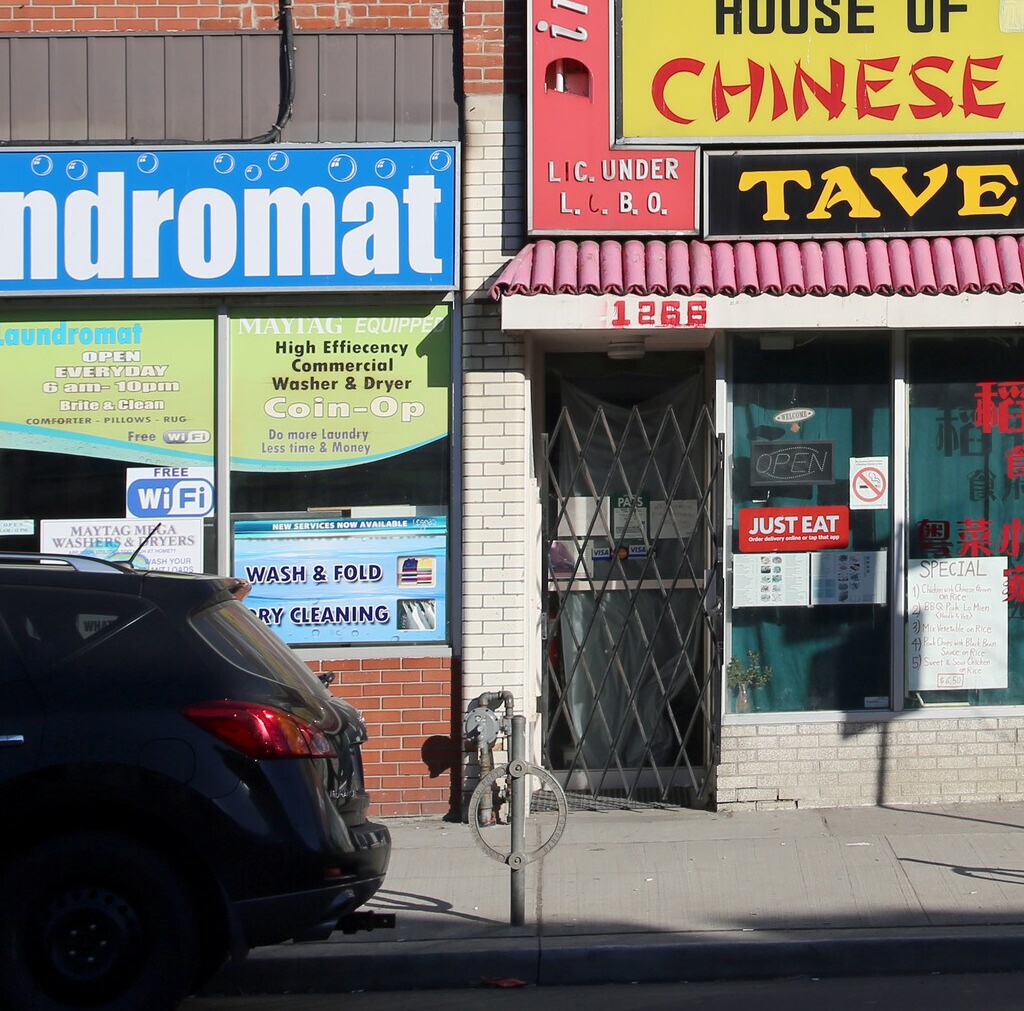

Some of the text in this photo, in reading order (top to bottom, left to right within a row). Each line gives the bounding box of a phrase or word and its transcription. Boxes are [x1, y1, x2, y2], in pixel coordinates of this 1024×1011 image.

[652, 54, 1006, 123] CHINESE
[601, 157, 679, 181] UNDER
[0, 172, 443, 280] ndromat
[612, 300, 706, 327] 1266
[238, 317, 446, 335] MAYTAG EQUIPPED
[0, 321, 142, 346] aundromat
[276, 340, 408, 357] High Effiecency
[82, 351, 141, 363] OPEN
[55, 365, 169, 378] EVERYDAY
[291, 358, 393, 373] Commercial
[42, 381, 58, 393] 6
[114, 380, 180, 393] 10pm
[272, 376, 412, 392] Washer & Dryer
[59, 399, 165, 411] Brite & Clean
[264, 395, 425, 423] Coin-Op
[26, 415, 187, 425] COMFORTER PILLOWS RUG
[781, 411, 808, 421] WELCOME
[128, 431, 156, 442] Free
[268, 428, 369, 441] Do more Laundry
[261, 442, 371, 454] Less time & Money
[756, 452, 827, 474] OPEN
[154, 467, 189, 477] FREE
[71, 524, 176, 536] MAYTAG MEGA
[272, 523, 292, 531] NEW
[293, 521, 335, 530] SERVICES
[336, 521, 359, 529] NOW
[360, 519, 408, 528] AVAILABLE
[749, 515, 840, 535] JUST EAT
[52, 535, 194, 548] WASHERS & DRYERS
[630, 546, 646, 554] VISA
[169, 557, 191, 565] YOUR
[246, 564, 382, 584] WASH & FOLD
[920, 559, 987, 578] SPECIAL
[950, 593, 967, 601] Rice
[924, 602, 943, 612] BBQ
[249, 606, 390, 624] RY CLEANING
[922, 623, 936, 633] Mix
[976, 624, 992, 634] Rice
[969, 648, 986, 657] Rice
